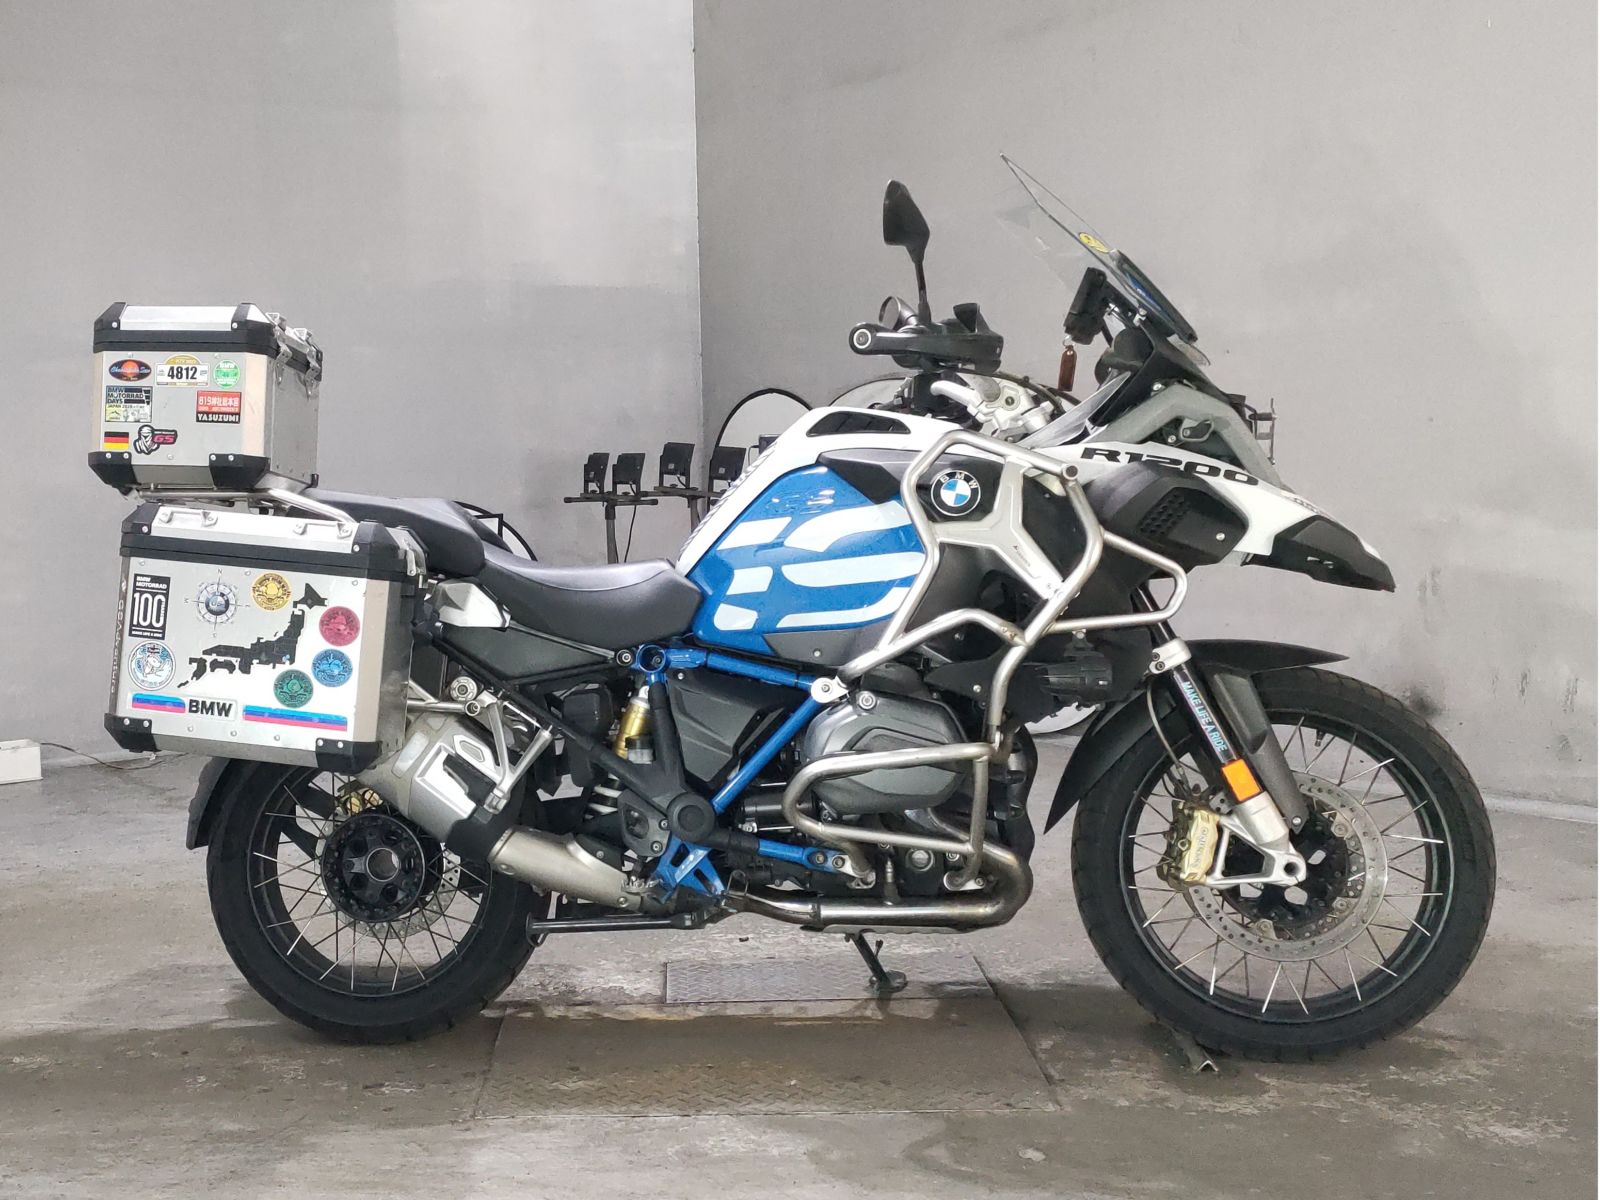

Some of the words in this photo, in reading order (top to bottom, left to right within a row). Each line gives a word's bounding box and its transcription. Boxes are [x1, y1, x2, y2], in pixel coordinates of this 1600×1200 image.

[167, 366, 198, 380] 4812
[197, 413, 240, 422] YASUZUMI
[153, 434, 175, 444] GS
[1080, 447, 1259, 486] R1200
[940, 471, 979, 488] BMW
[135, 581, 168, 590] MOTORRAD
[132, 592, 166, 628] 100
[188, 699, 233, 718] BMW
[1183, 681, 1202, 706] MAKE
[1195, 705, 1212, 727] LIFE
[1209, 731, 1228, 752] RIDE
